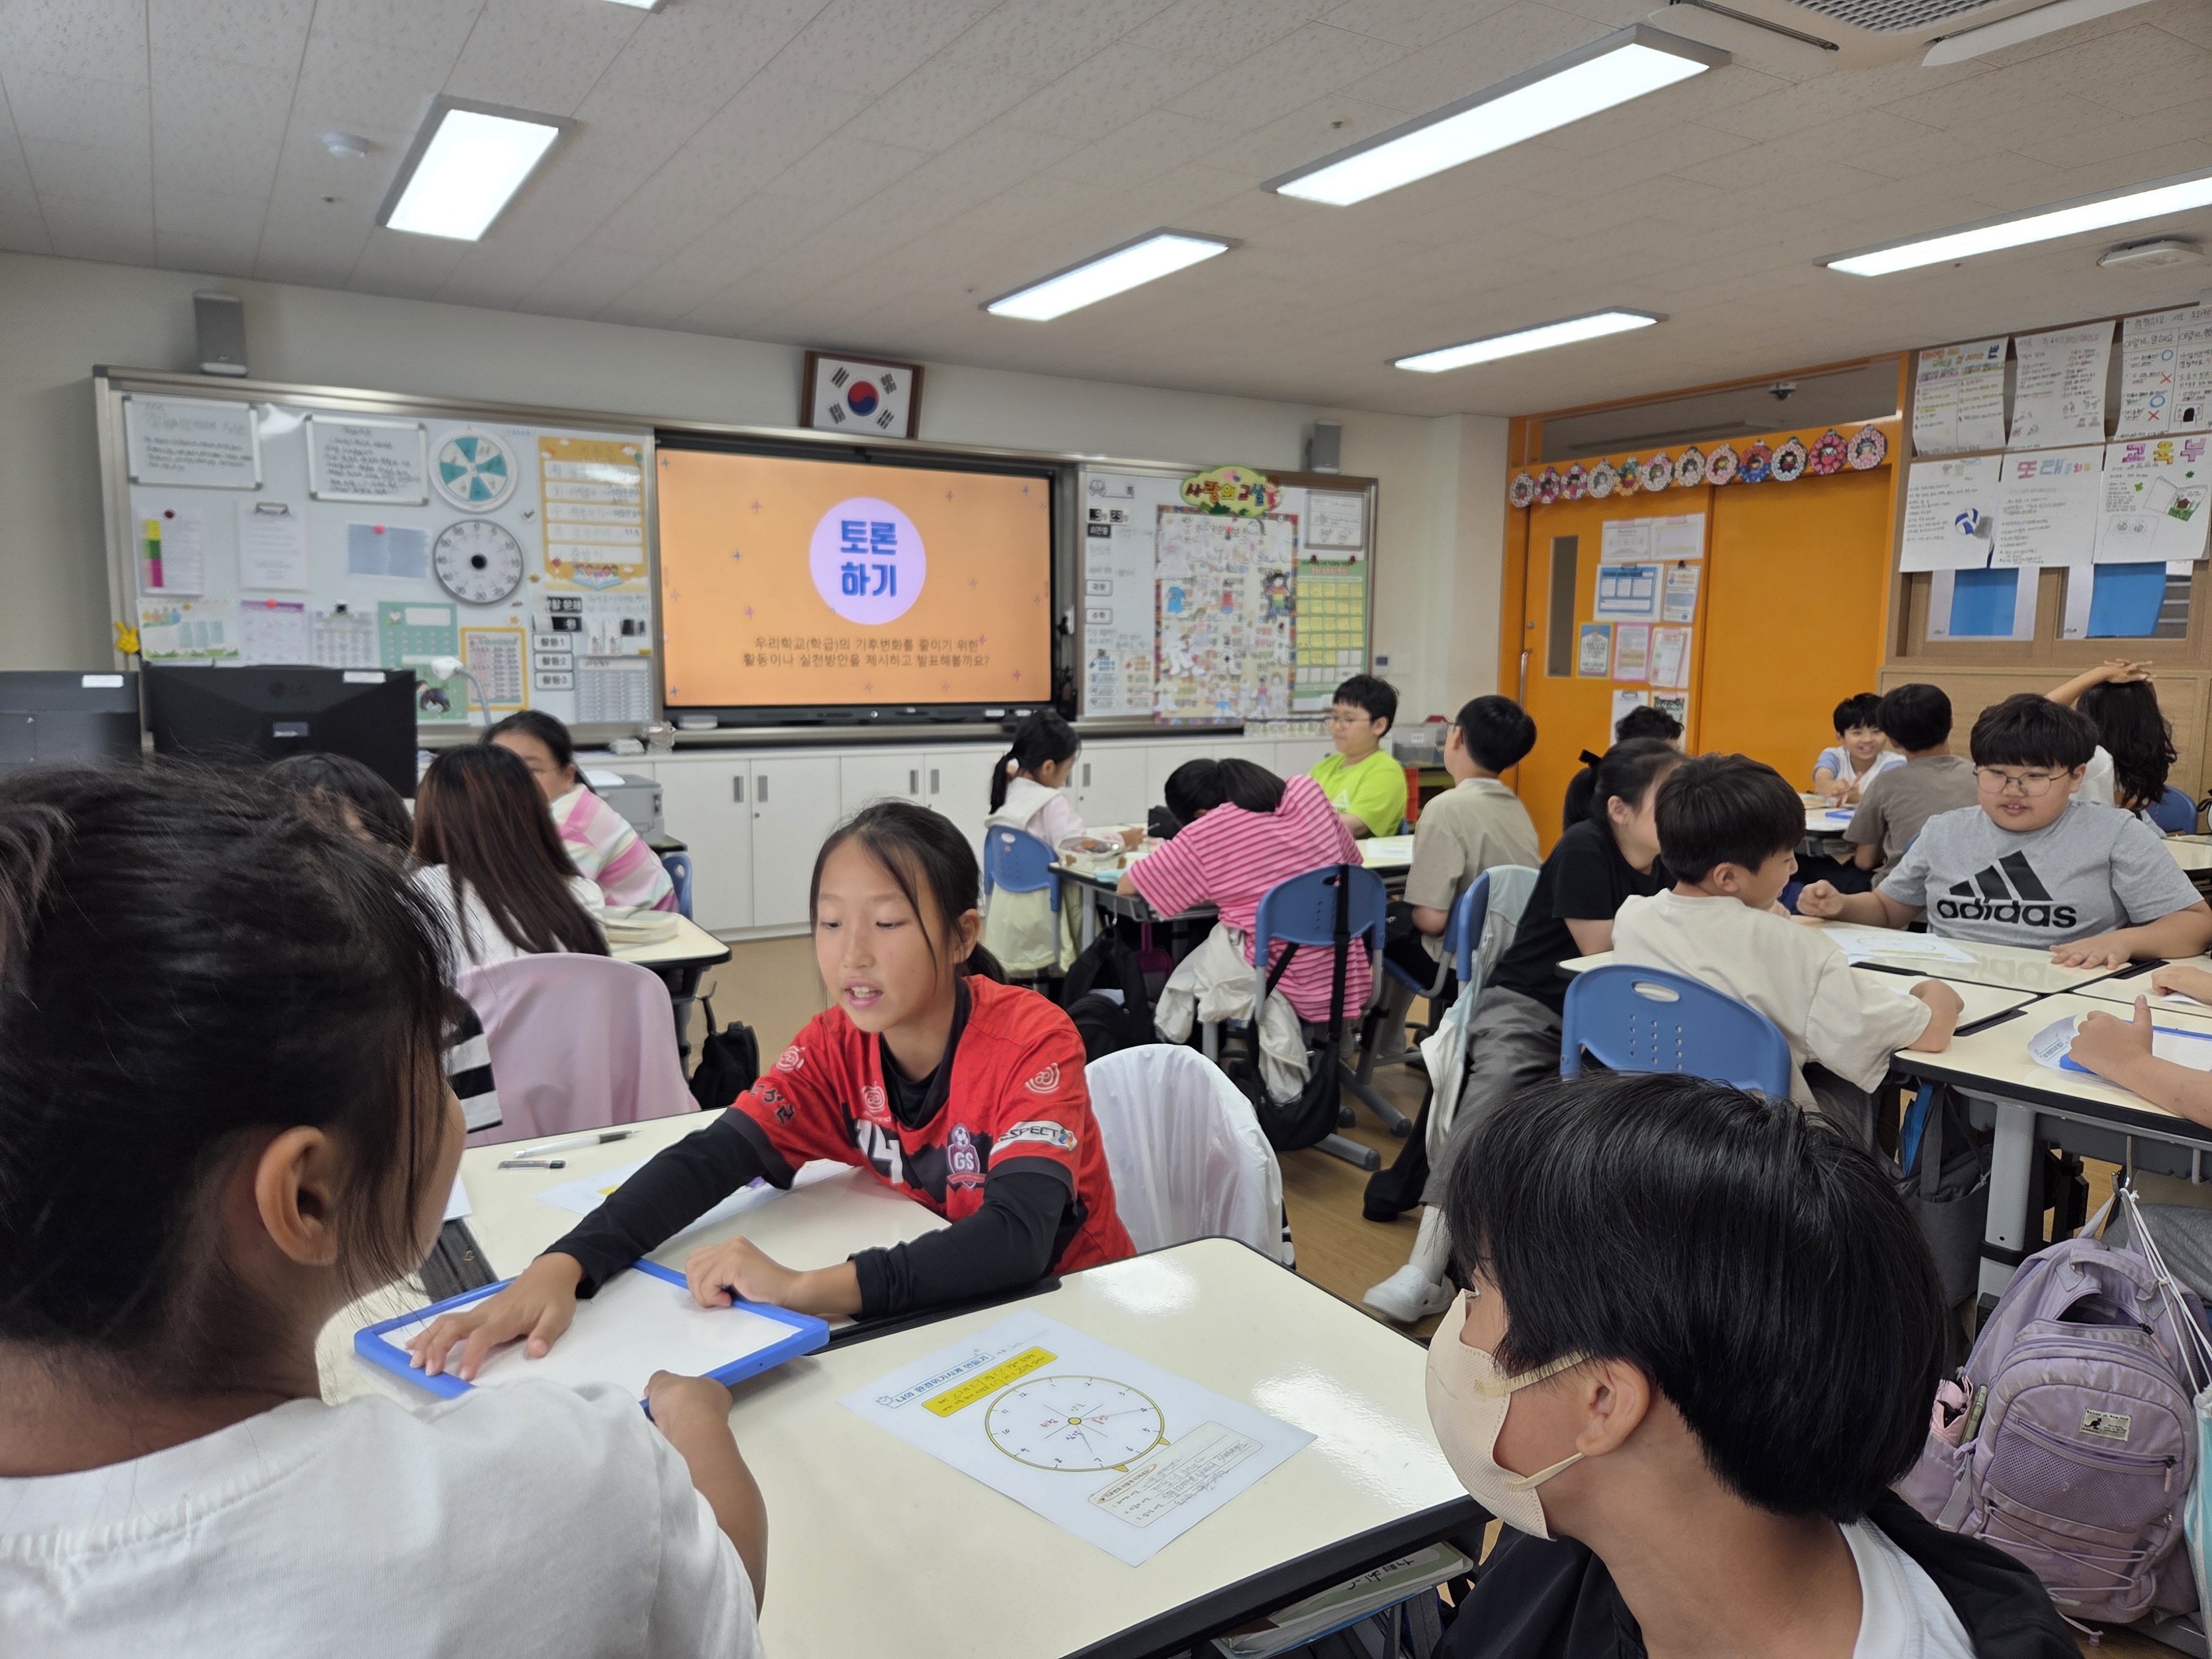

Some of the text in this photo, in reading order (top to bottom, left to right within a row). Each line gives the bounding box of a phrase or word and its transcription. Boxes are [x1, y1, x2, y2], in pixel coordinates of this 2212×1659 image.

[841, 520, 898, 555] 토론
[841, 562, 897, 597] 하기
[755, 637, 979, 653] 우리학교(학급)의 기후변화를 줄이기 위한
[743, 653, 794, 667] 활동이나
[800, 653, 860, 667] 실천방안을
[867, 654, 912, 667] 제시하고
[1937, 898, 2077, 928] adidas
[998, 1126, 1058, 1143] ESPECT
[954, 1152, 975, 1170] GS
[895, 1391, 915, 1402] 나의
[914, 1367, 963, 1392] 환경위기시계
[962, 1355, 988, 1369] 만들기
